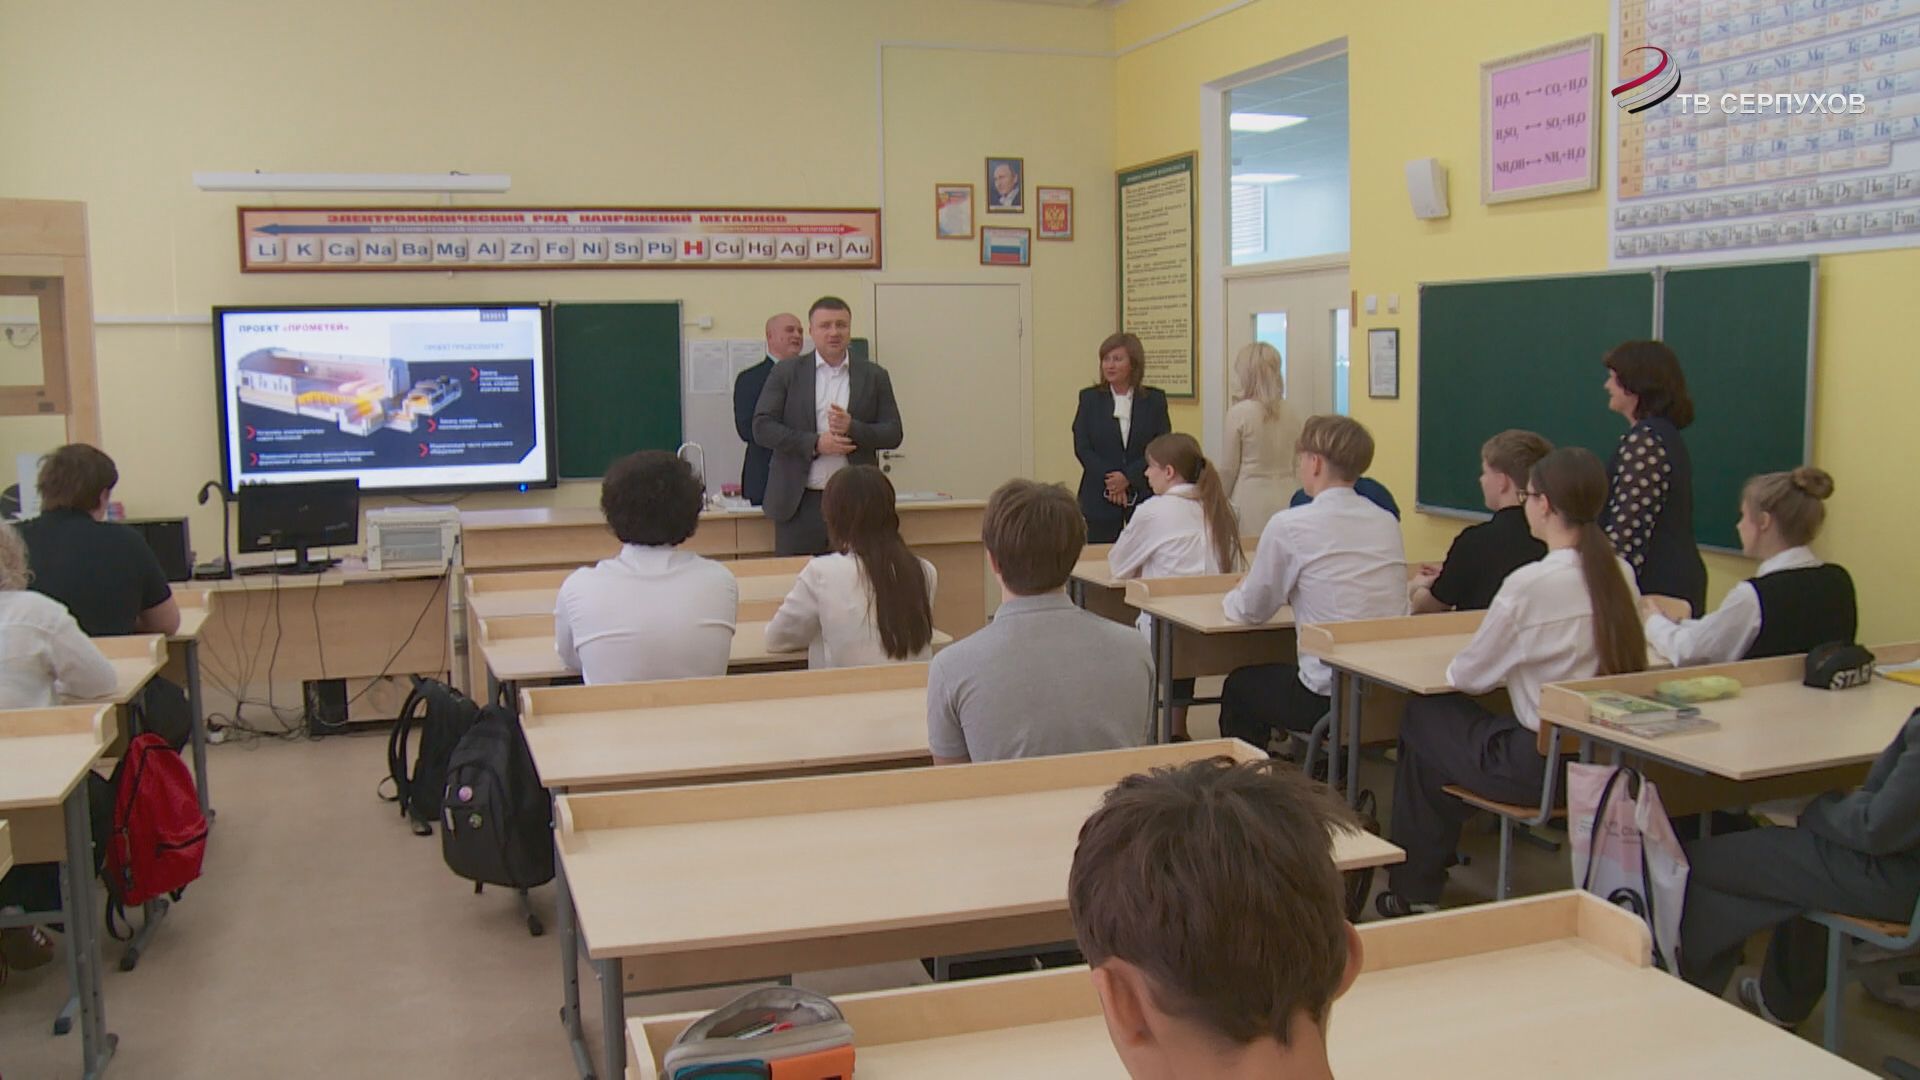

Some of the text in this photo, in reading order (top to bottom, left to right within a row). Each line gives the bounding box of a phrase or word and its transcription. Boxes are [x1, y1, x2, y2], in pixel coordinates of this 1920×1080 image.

[327, 214, 787, 224] ЭЛЕКТРОХИМИЧЕСКИЙ РЯД НАПРЯЖЕНИЙ МЕТАЛЛОВ
[258, 240, 869, 258] Li K Ca Na Ba Mg Al Zn Fe Ni Sn Pb H Cu Hg Ag Pt Au
[239, 324, 279, 333] ПРОЕКТ
